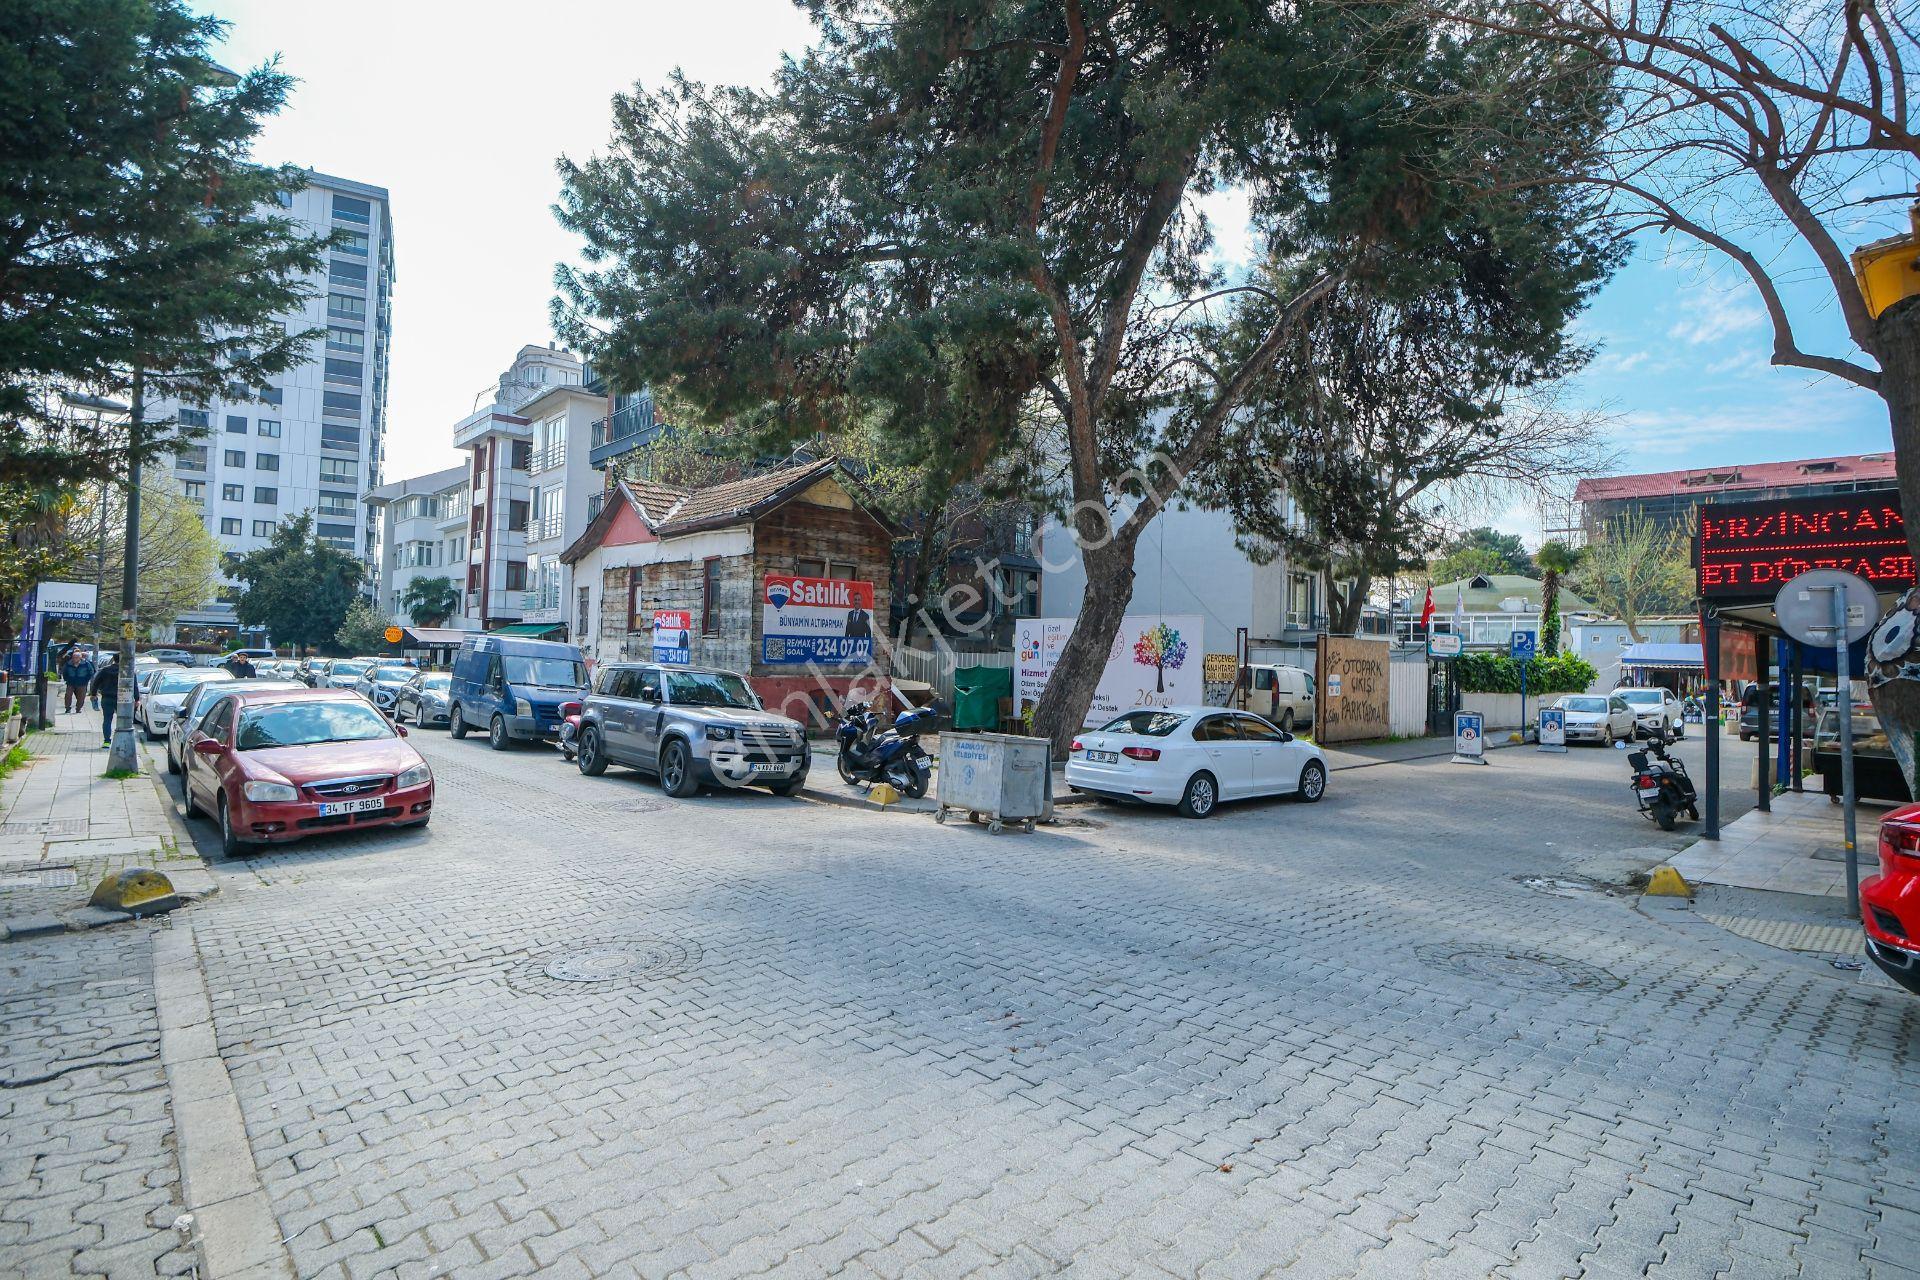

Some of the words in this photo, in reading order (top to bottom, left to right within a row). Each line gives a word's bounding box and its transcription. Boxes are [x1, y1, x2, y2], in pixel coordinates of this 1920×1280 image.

[1703, 563, 1742, 584] ET
[792, 579, 851, 606] Satılık
[44, 599, 90, 610] bisiklethane
[661, 613, 682, 628] Satılık
[779, 615, 809, 627] BÜNYAMİN
[1047, 624, 1061, 633] özel
[786, 638, 811, 648] RE/MAX
[1513, 632, 1527, 648] P
[816, 638, 838, 656] 234
[840, 639, 854, 657] 07
[856, 639, 870, 657] 07
[1021, 649, 1039, 662] gün
[1021, 669, 1048, 678] Hizmet
[1343, 659, 1382, 677] OTOPARK
[1092, 694, 1110, 702] leksi)
[1134, 688, 1154, 707] 26
[1097, 704, 1119, 712] Destek
[326, 803, 338, 814] 34
[343, 801, 355, 811] TF
[359, 798, 382, 810] 9605
